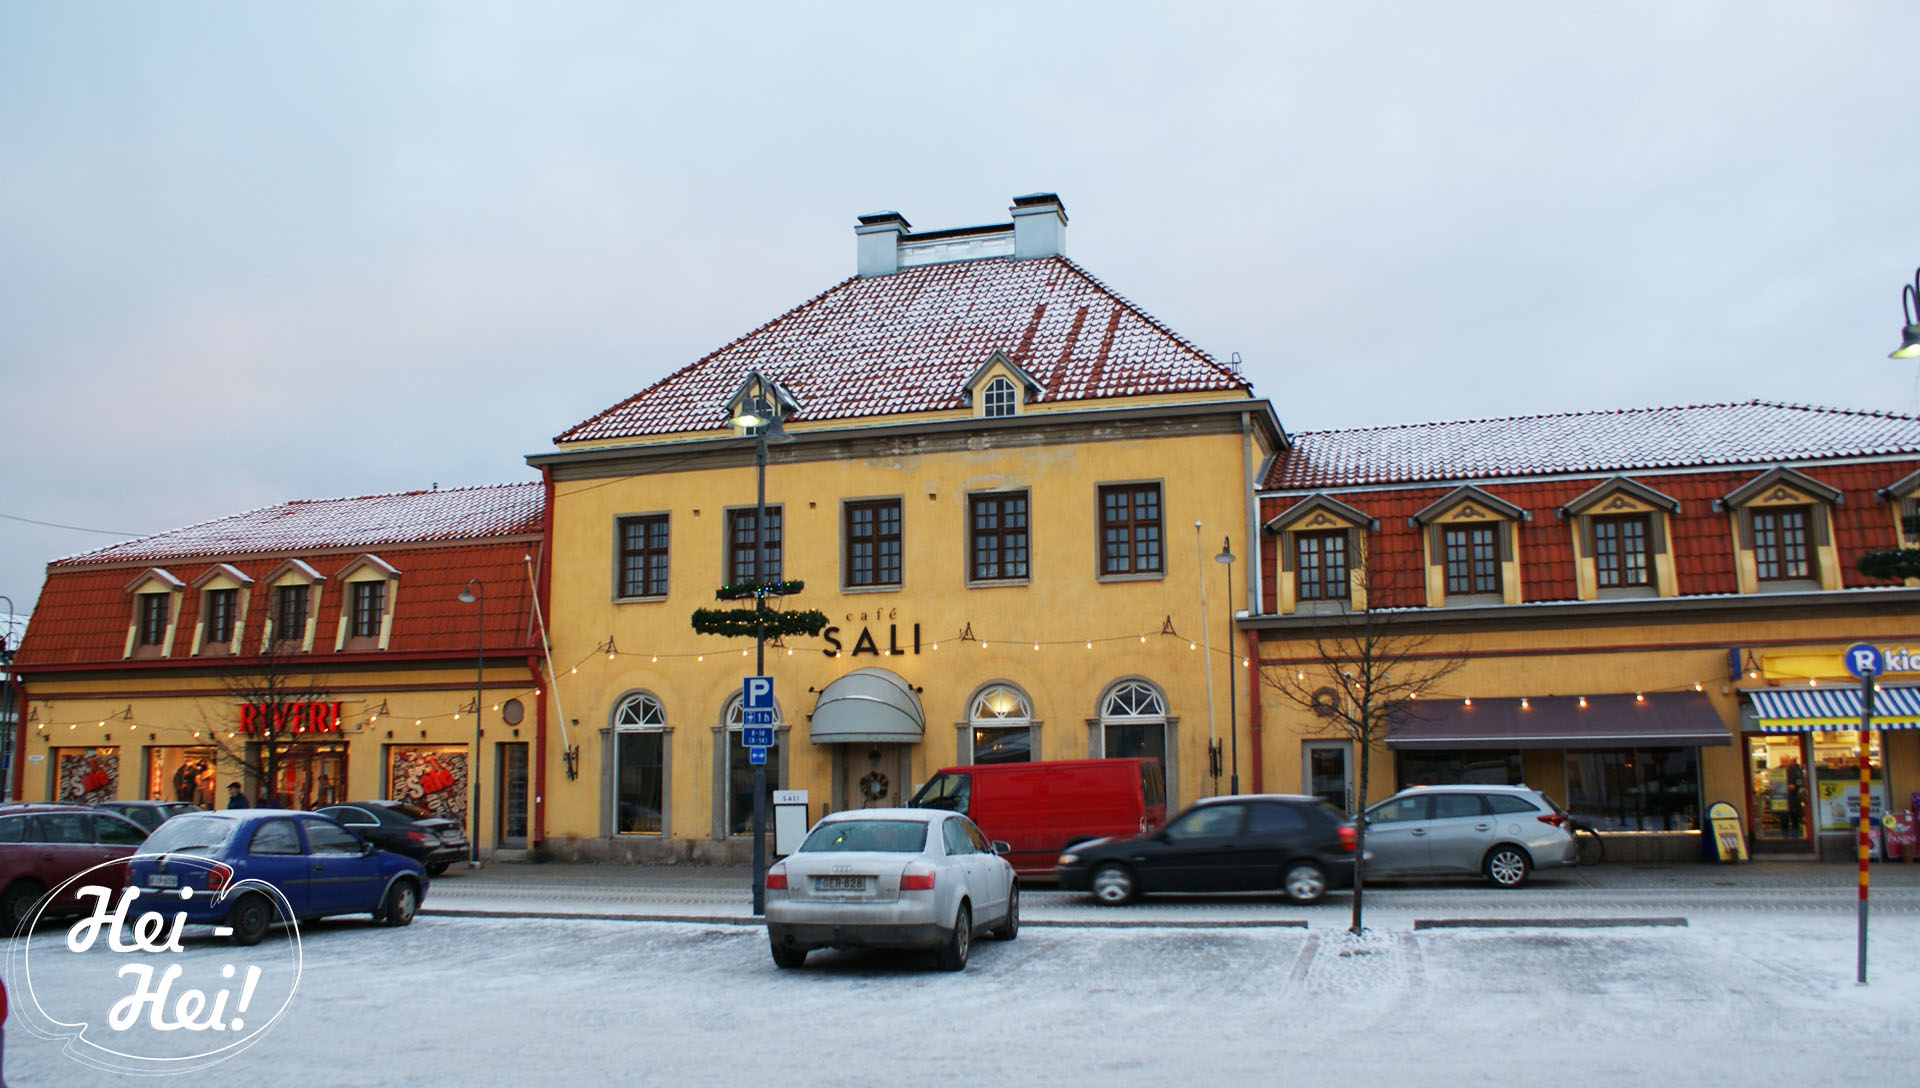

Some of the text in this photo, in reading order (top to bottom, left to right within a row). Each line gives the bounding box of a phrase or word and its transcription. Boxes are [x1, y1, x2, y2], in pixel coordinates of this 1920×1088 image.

[846, 608, 896, 622] café
[823, 623, 920, 657] SALI
[749, 679, 770, 707] P
[240, 702, 340, 733] RIVERI
[822, 877, 863, 888] GER-828
